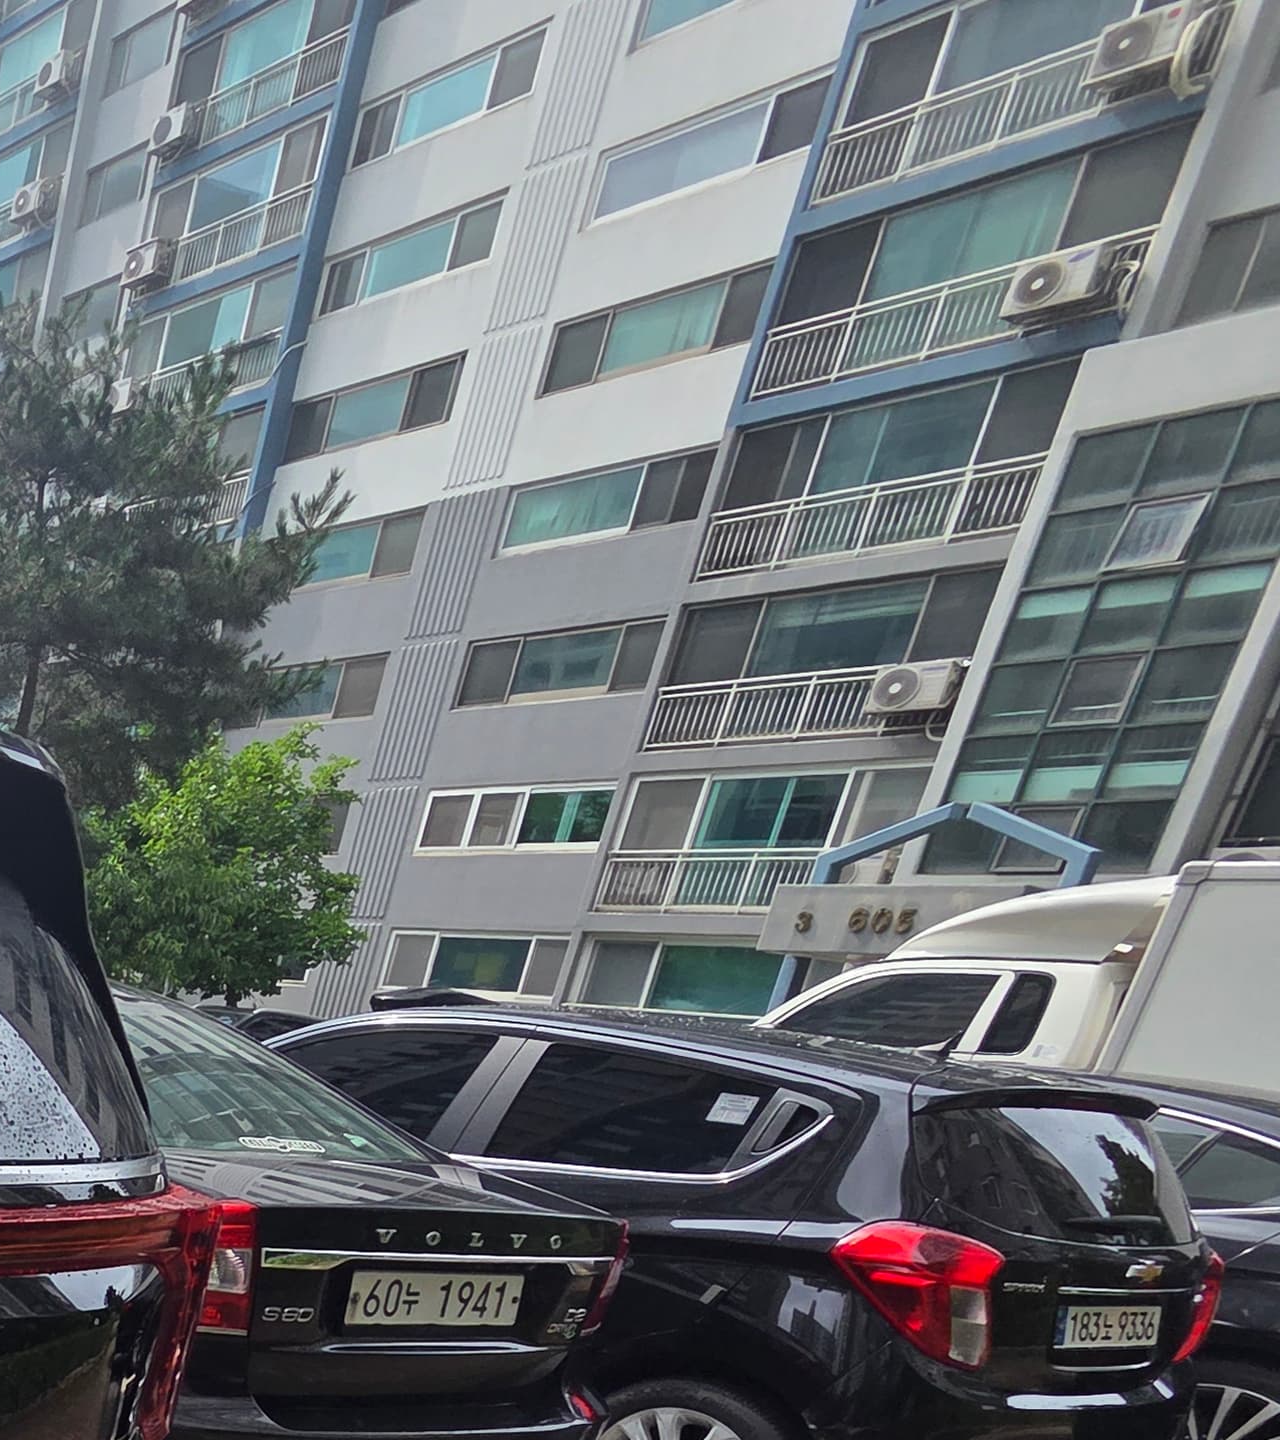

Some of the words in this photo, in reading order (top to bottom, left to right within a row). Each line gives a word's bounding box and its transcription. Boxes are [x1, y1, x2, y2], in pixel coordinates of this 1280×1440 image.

[795, 911, 814, 934] 3
[848, 907, 918, 935] 605
[376, 1228, 562, 1250] VOLVO
[440, 1280, 509, 1319] 1941
[1070, 1311, 1114, 1342] 183노
[1118, 1311, 1156, 1341] 9336
